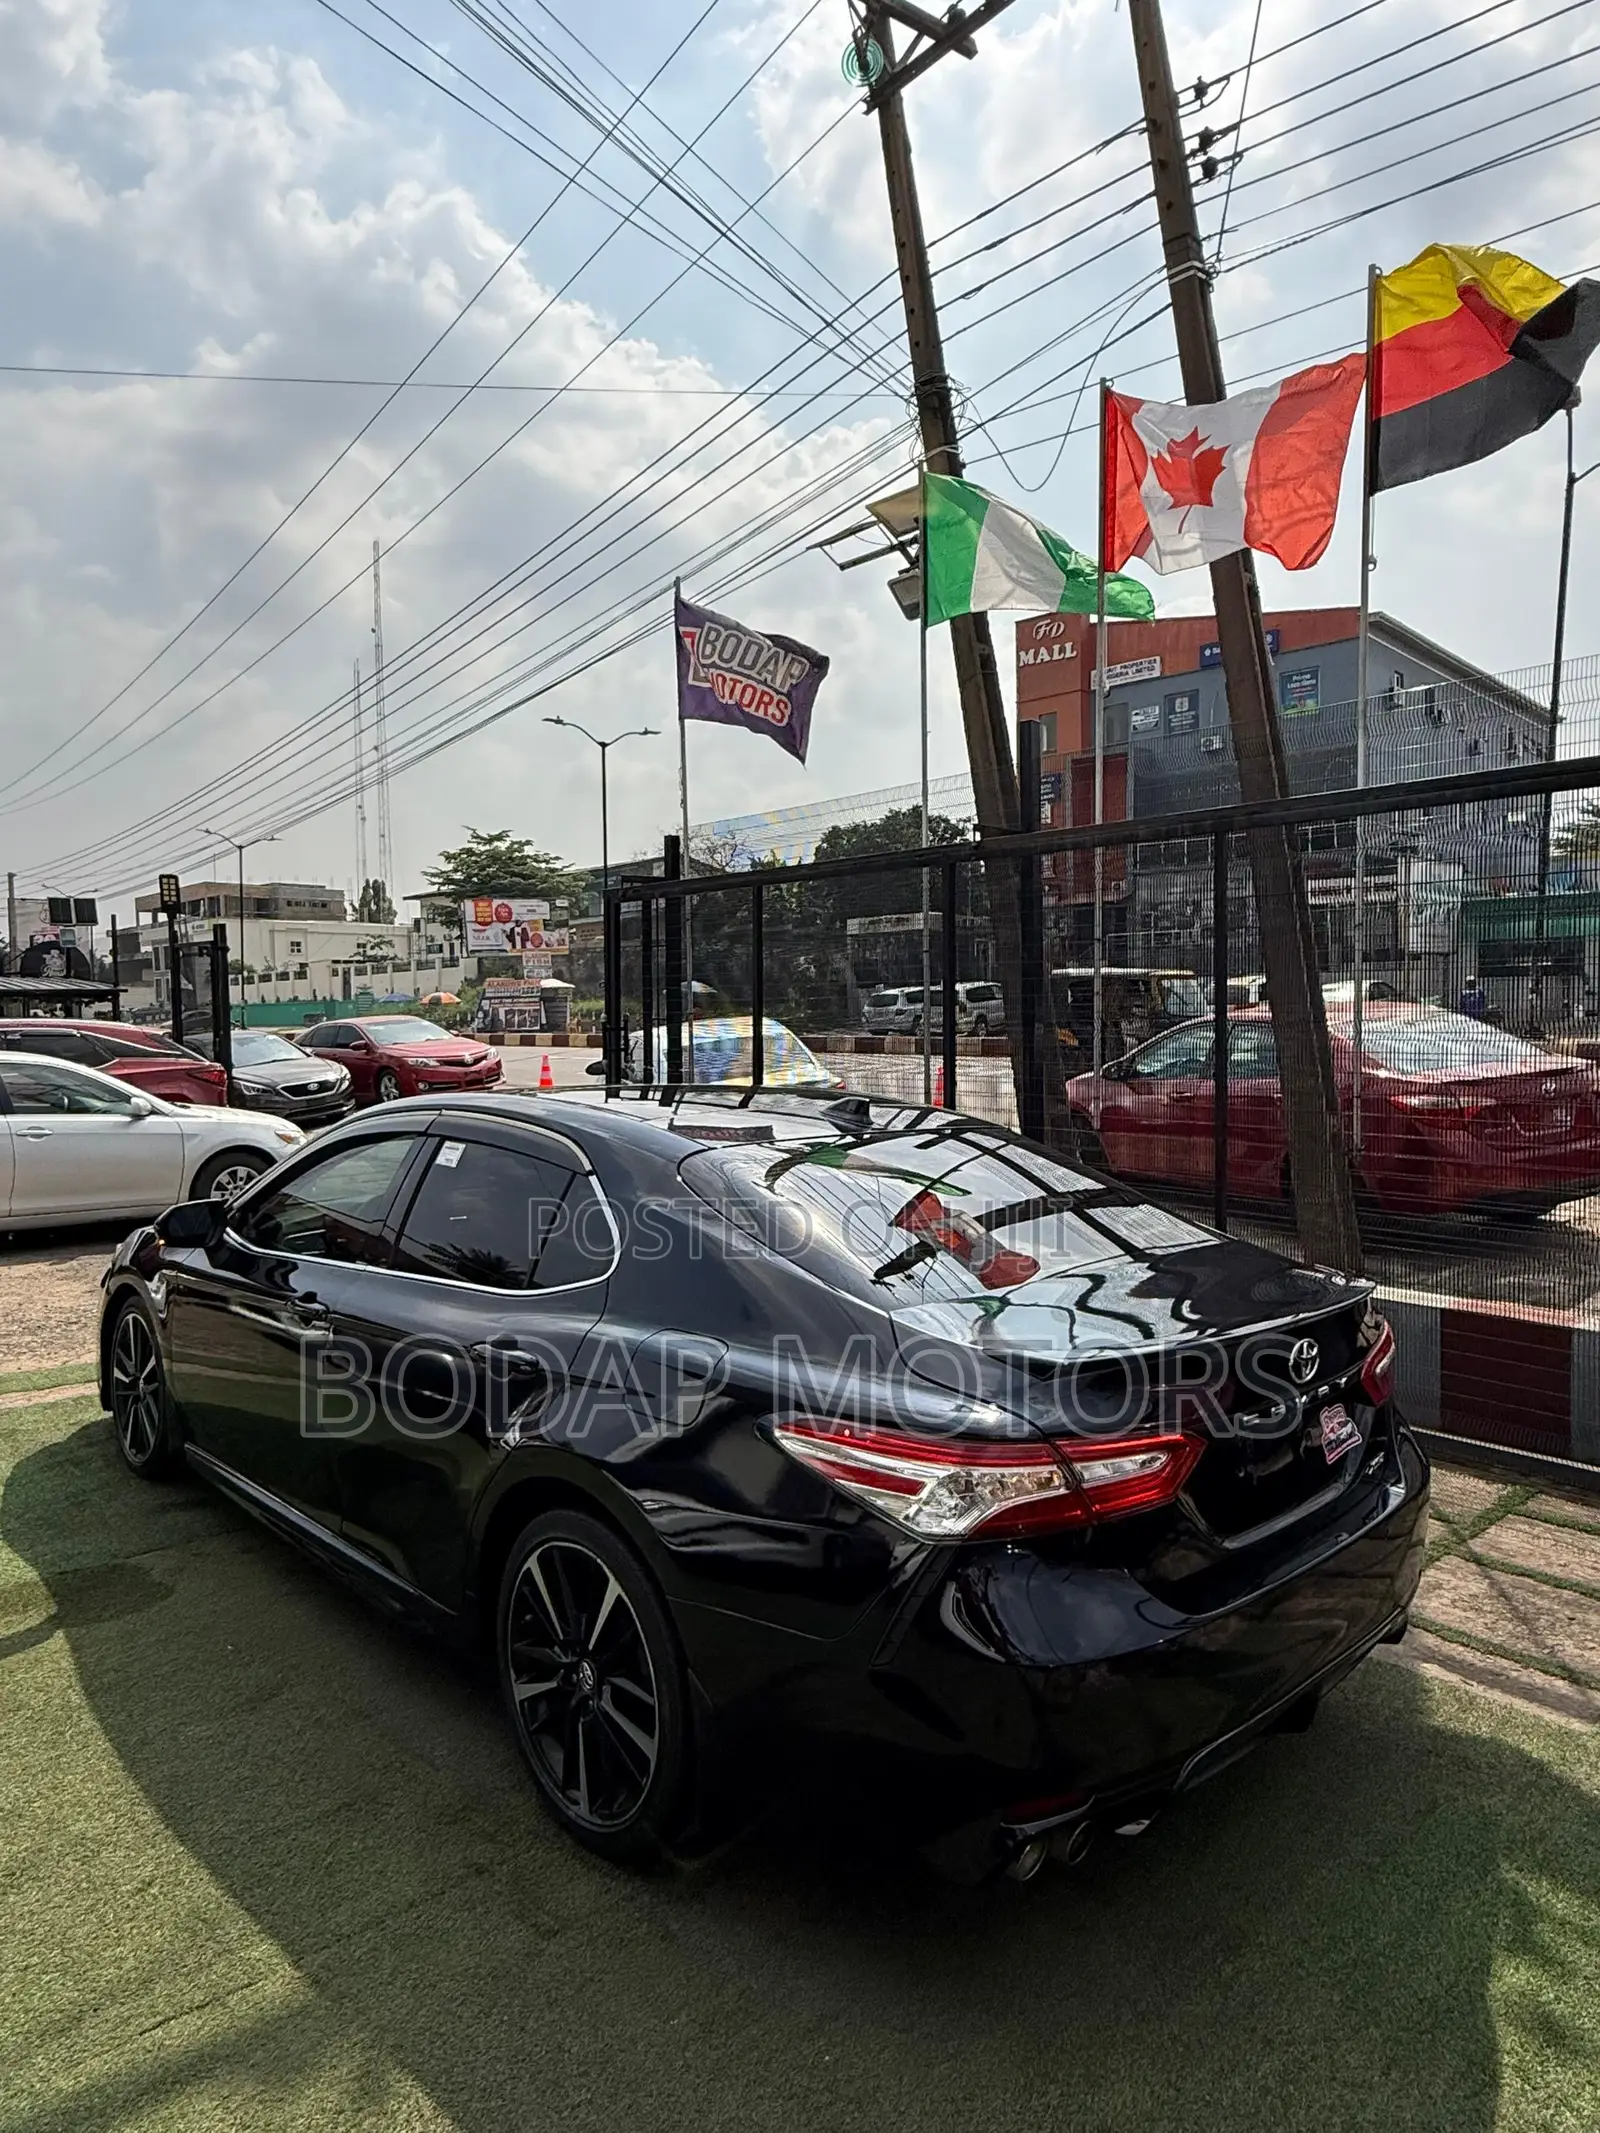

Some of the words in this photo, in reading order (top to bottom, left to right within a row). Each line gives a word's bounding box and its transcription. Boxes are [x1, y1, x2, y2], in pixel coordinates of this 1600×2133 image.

[700, 623, 810, 692] BODAP
[1019, 641, 1077, 667] MALL
[1119, 658, 1157, 671] PROPERTIES
[1131, 665, 1156, 676] LIMITED
